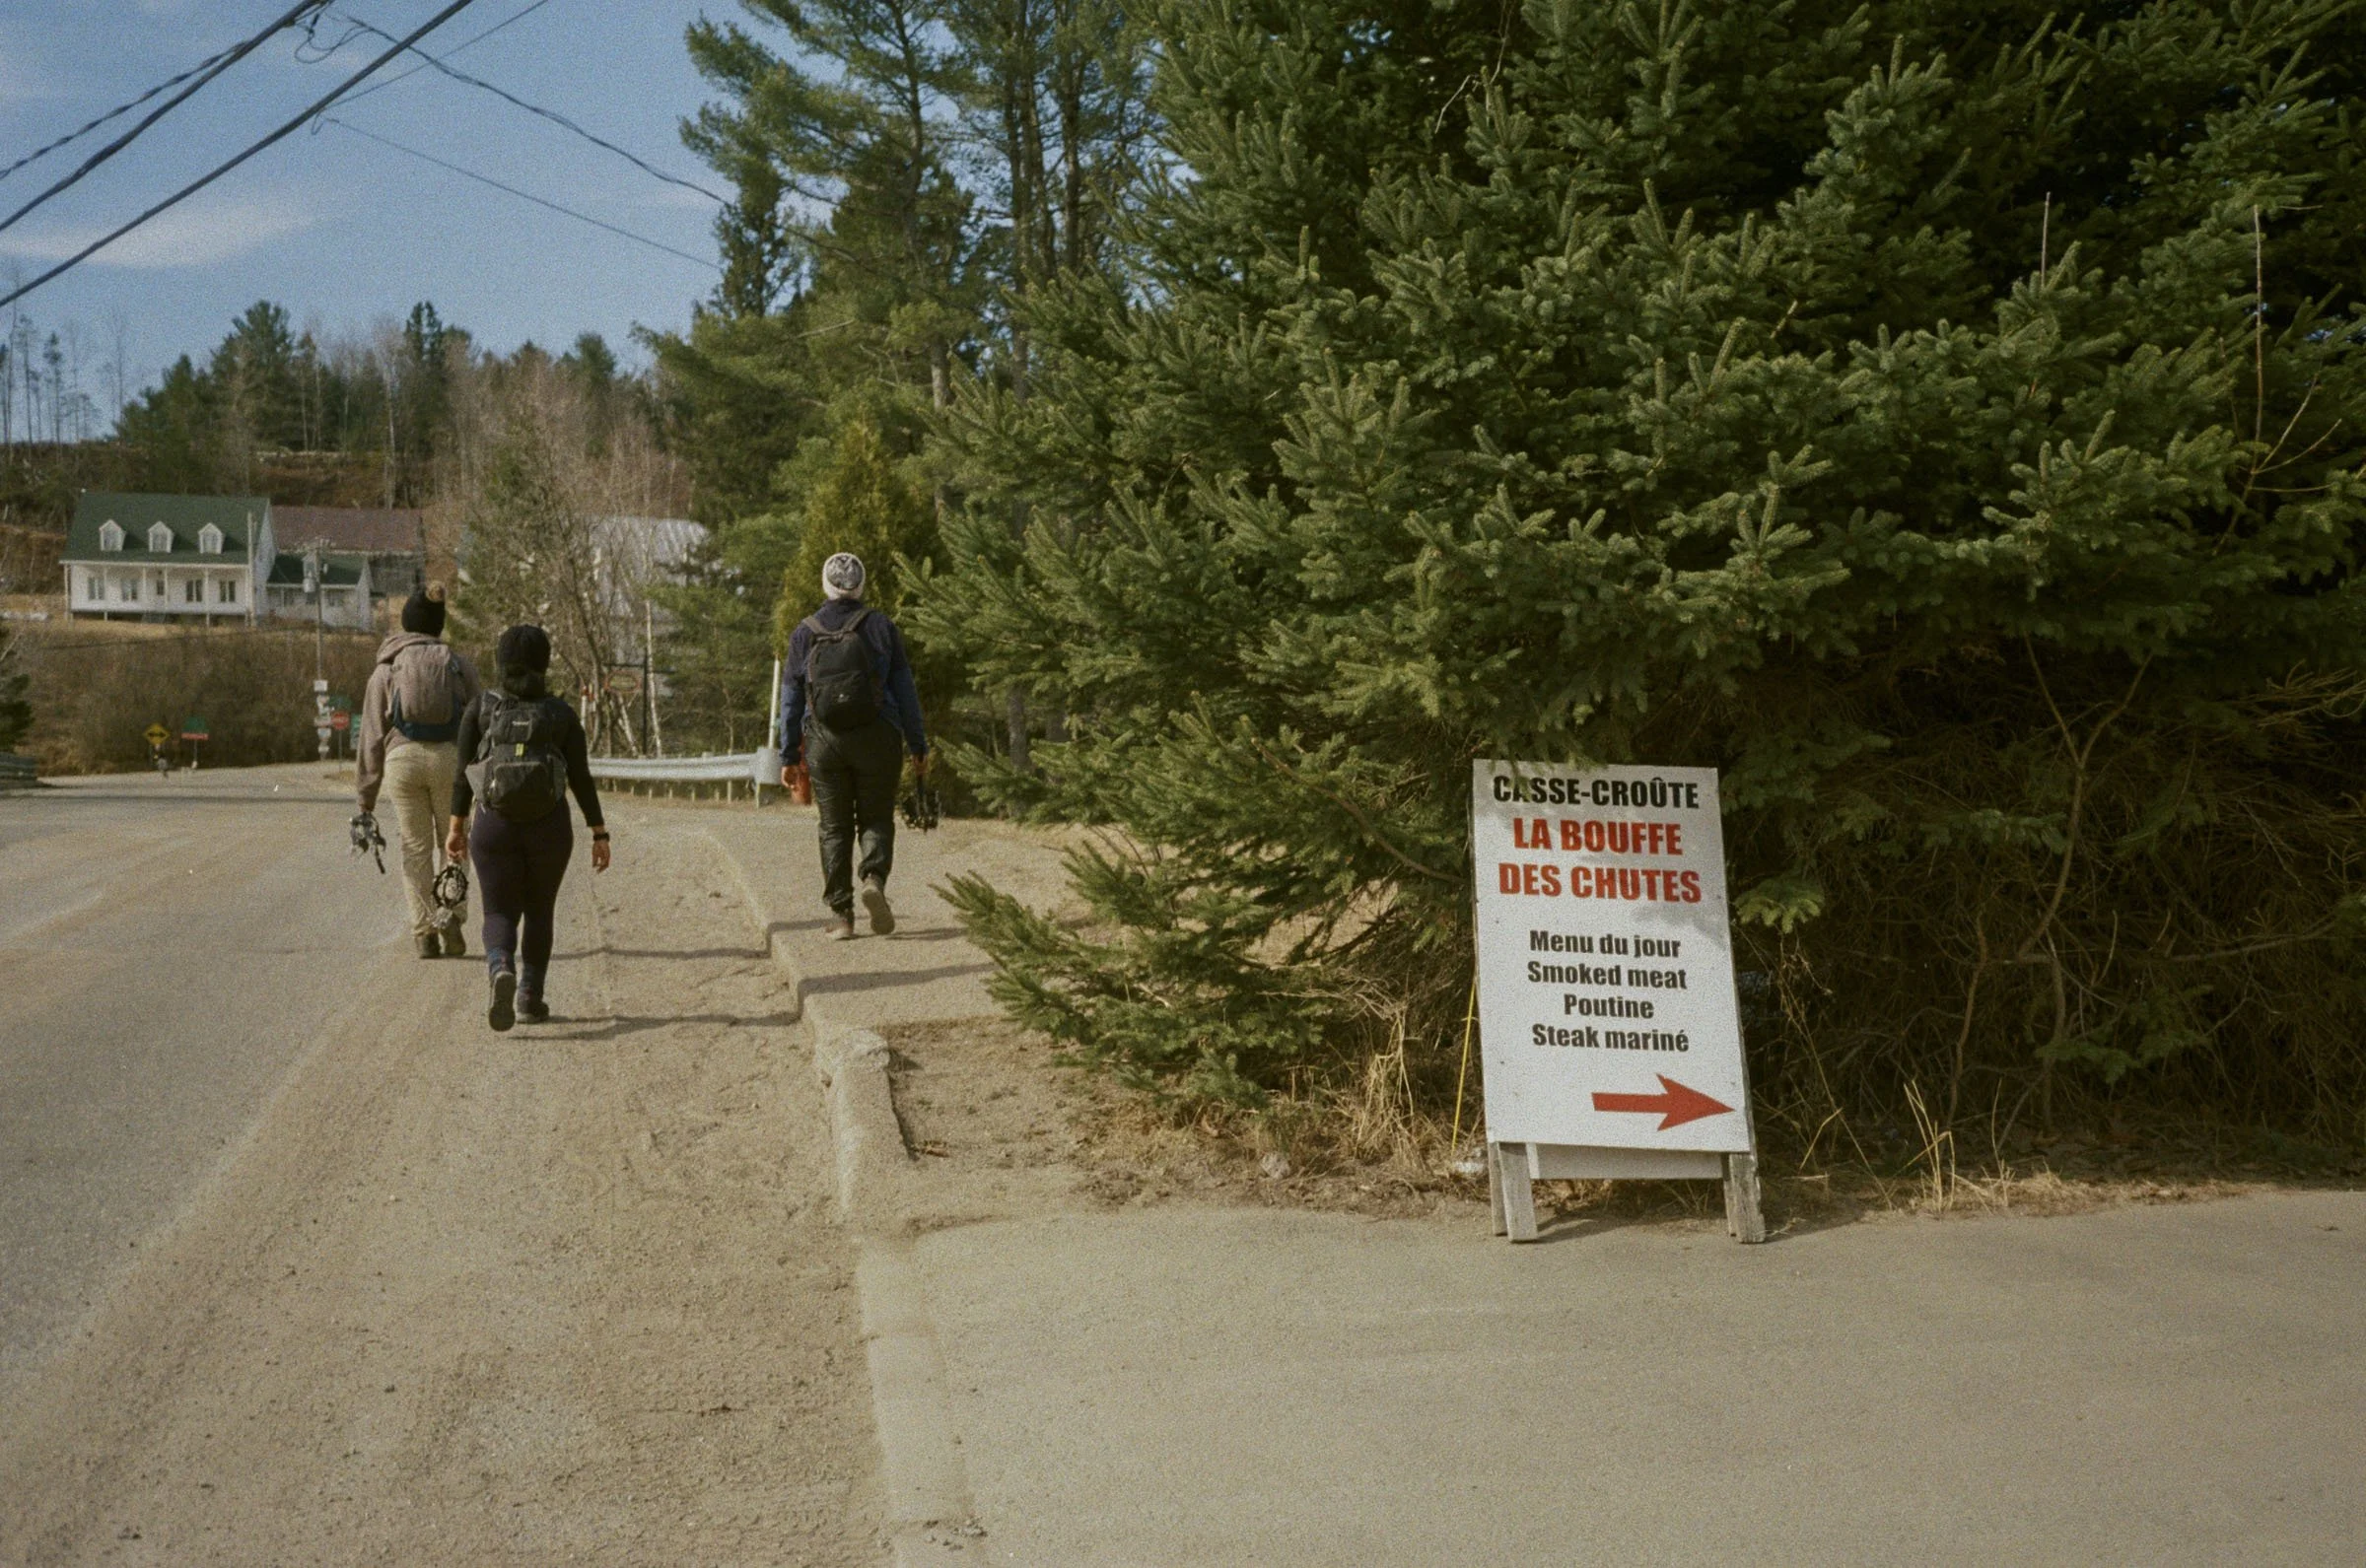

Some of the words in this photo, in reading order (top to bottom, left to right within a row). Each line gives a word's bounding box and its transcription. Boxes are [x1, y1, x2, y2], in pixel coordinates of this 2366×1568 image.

[1493, 775, 1700, 809] CASSE-CROÛTE
[1512, 817, 1553, 850] LA
[1560, 819, 1684, 855] BOUFFE
[1497, 862, 1562, 896] DES
[1570, 865, 1702, 904] CHUTES
[1529, 929, 1594, 953] Menu
[1599, 933, 1629, 955] du
[1634, 935, 1681, 958] jour
[1527, 960, 1622, 986] Smoked
[1628, 968, 1688, 989] meat
[1564, 993, 1654, 1019] Poutine
[1532, 1023, 1600, 1048] Steak
[1605, 1028, 1690, 1053] mariné
